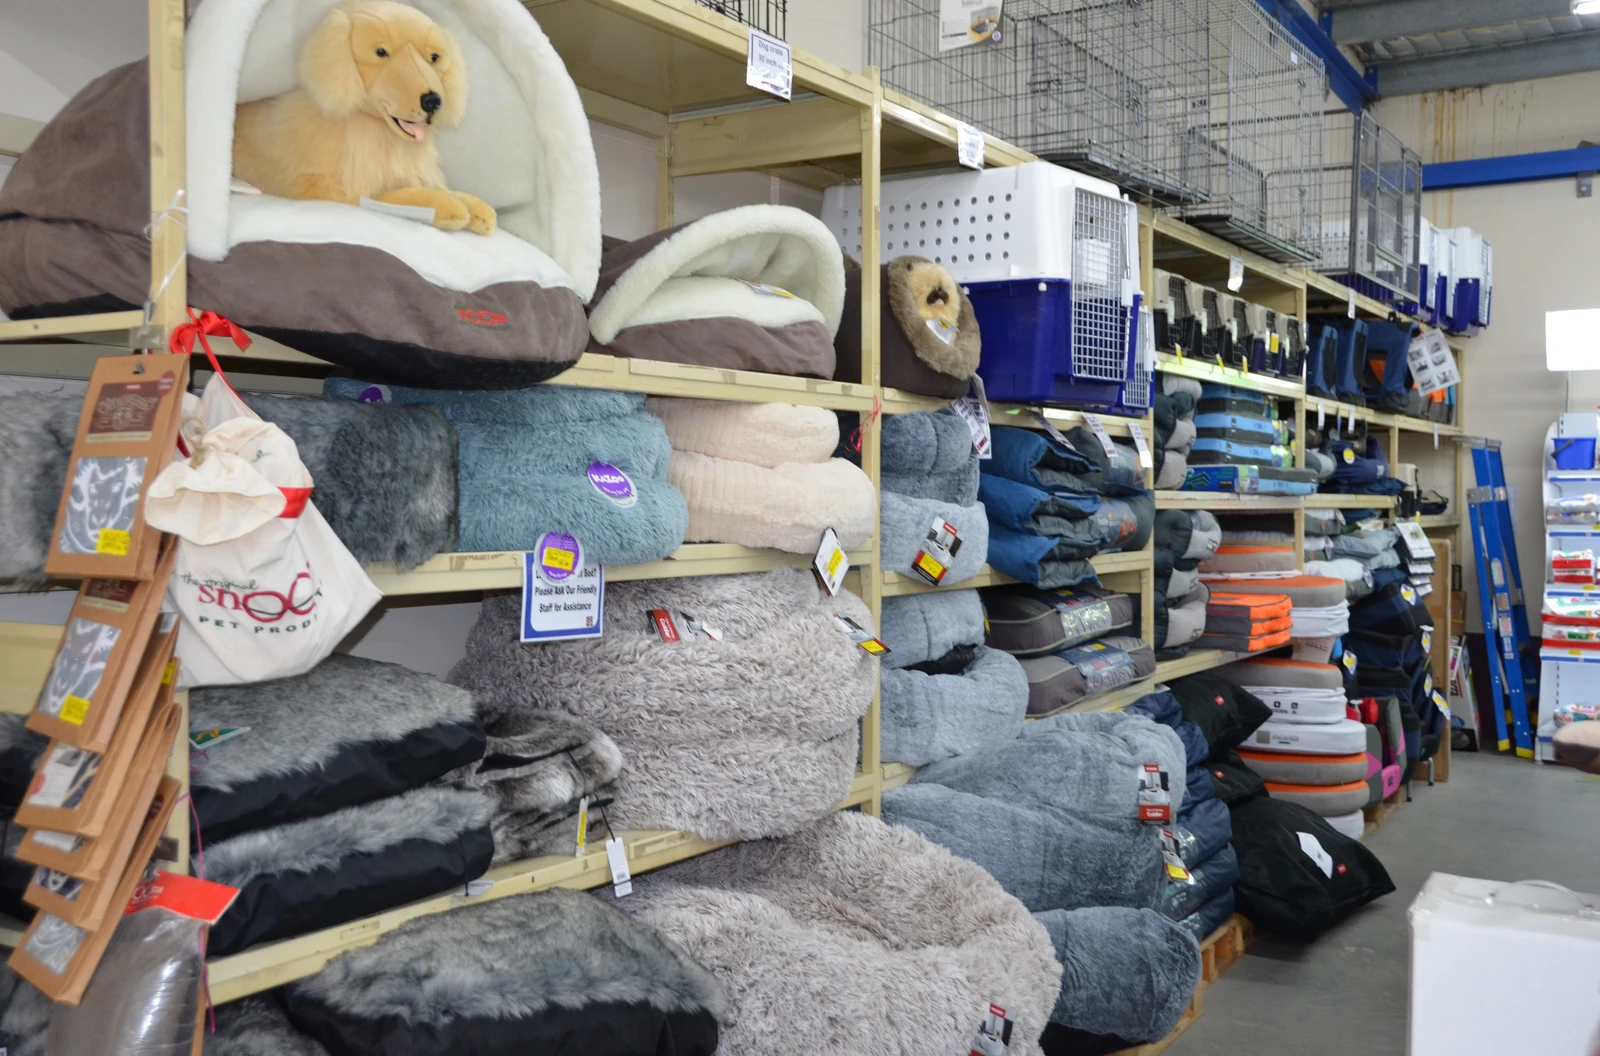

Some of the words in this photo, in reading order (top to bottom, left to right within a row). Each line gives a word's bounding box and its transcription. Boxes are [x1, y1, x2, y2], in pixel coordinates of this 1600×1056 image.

[180, 572, 200, 587] the
[202, 578, 259, 594] original
[534, 585, 553, 597] Please
[554, 585, 565, 596] Ask
[565, 584, 576, 595] Our
[576, 584, 598, 597] Friendly
[538, 601, 553, 613] Staff
[554, 601, 562, 612] for
[562, 600, 592, 612] Assistance
[199, 615, 240, 629] PET
[254, 614, 317, 634] PROD
